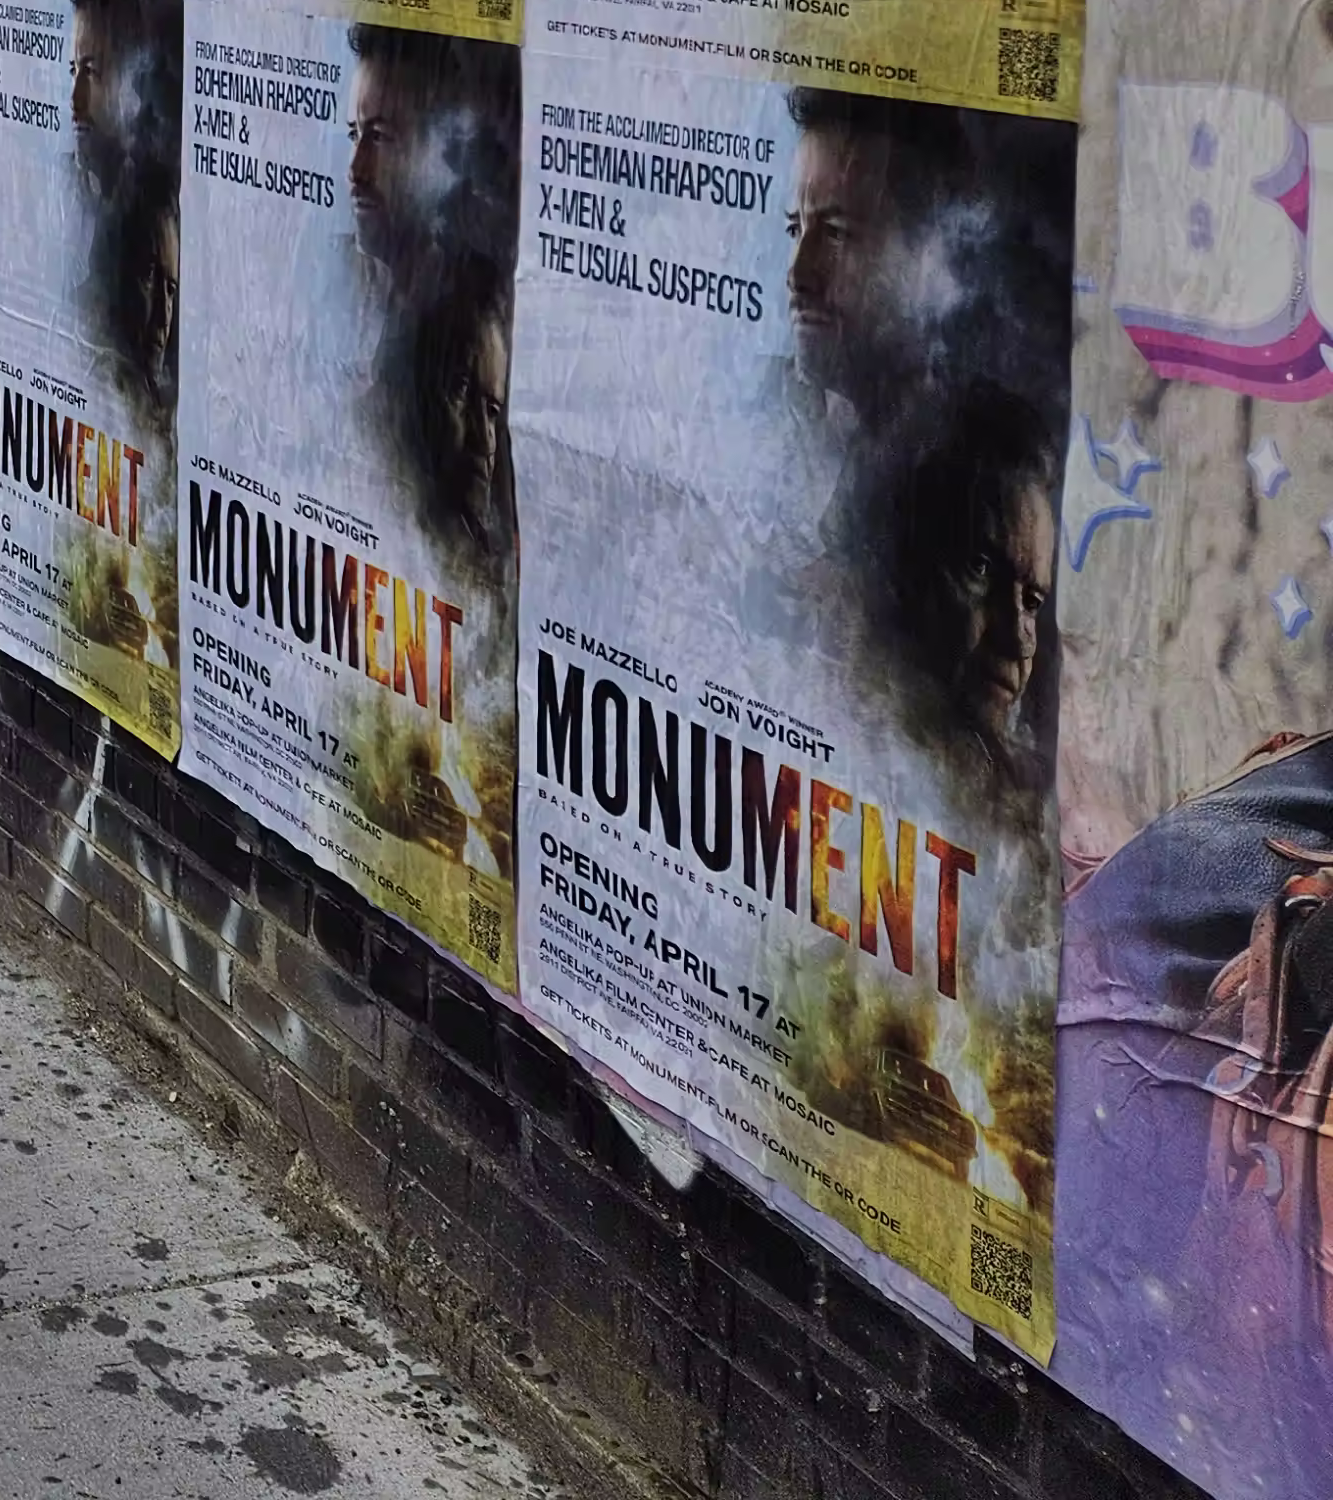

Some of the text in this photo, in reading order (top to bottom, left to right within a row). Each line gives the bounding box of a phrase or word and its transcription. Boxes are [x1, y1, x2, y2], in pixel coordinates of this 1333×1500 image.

[541, 135, 773, 215] BOHEMIAN RHAPSODY
[542, 103, 775, 164] FROM THE ACCLAIMED DIRECTOR OF
[539, 183, 626, 237] X-MEN &
[538, 231, 763, 322] THE USUAL SUSPECTS
[191, 455, 379, 550] JOE MAZZELLO JON VOIGHT
[189, 480, 463, 724] MONUMENT
[193, 627, 272, 688] OPENING
[540, 618, 835, 764] JOE MAZZELLO JON VOIGHT
[537, 649, 977, 1001] MONUMENT
[540, 832, 659, 921] OPENING
[539, 902, 792, 1067] ANGELIKA POP-UP AT UNION MARKET
[540, 864, 801, 1041] FRIDAY, APRIL 17 AT
[539, 937, 836, 1137] ANGELIKA FILM CENTER & CAFE AT MOSAIC
[540, 983, 564, 1008] GET
[564, 1001, 613, 1045] TICKETS
[614, 1035, 629, 1052] AT
[739, 1118, 761, 1143] OR
[761, 1134, 800, 1172] SCAN
[801, 1158, 832, 1187] THE
[834, 1181, 856, 1207] QR
[857, 1197, 902, 1236] CODE
